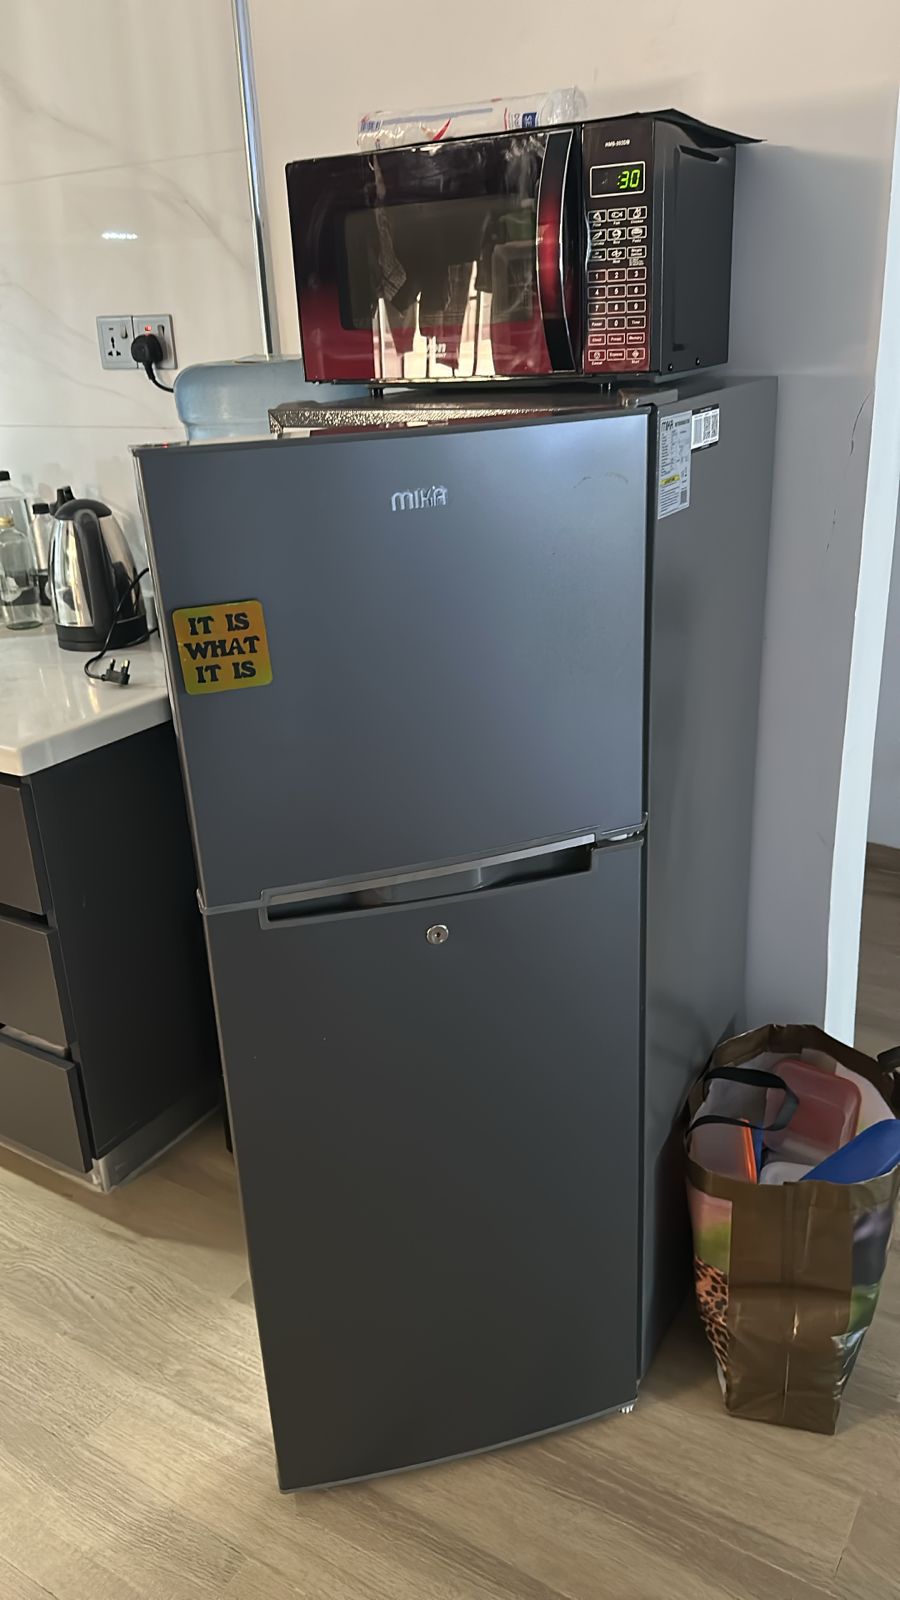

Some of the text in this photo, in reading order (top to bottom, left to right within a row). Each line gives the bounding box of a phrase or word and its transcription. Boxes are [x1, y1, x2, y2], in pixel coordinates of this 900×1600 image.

[188, 612, 250, 636] IT IS
[184, 635, 260, 661] WHAT
[195, 660, 256, 683] IT IS
